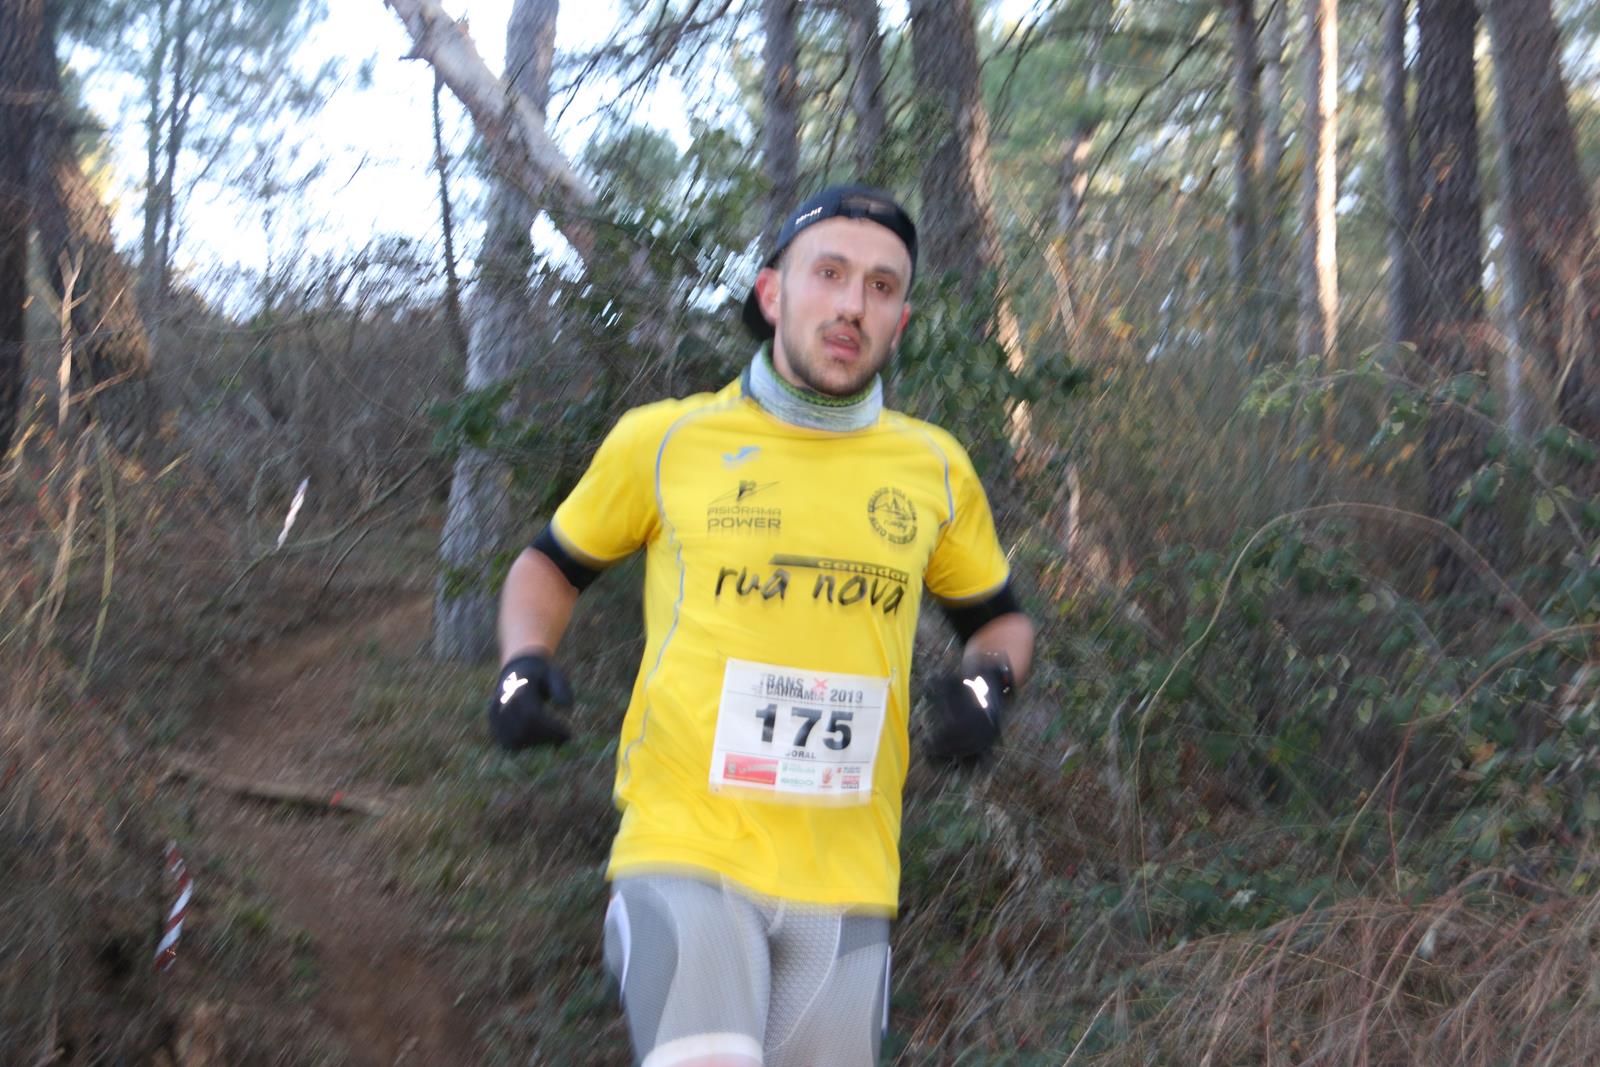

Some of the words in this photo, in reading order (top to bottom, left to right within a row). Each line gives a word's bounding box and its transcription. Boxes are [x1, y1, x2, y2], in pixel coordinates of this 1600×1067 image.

[706, 517, 782, 531] POWER
[714, 566, 791, 601] rua
[812, 573, 905, 616] nova
[829, 688, 864, 704] 2019
[755, 703, 854, 751] 175
